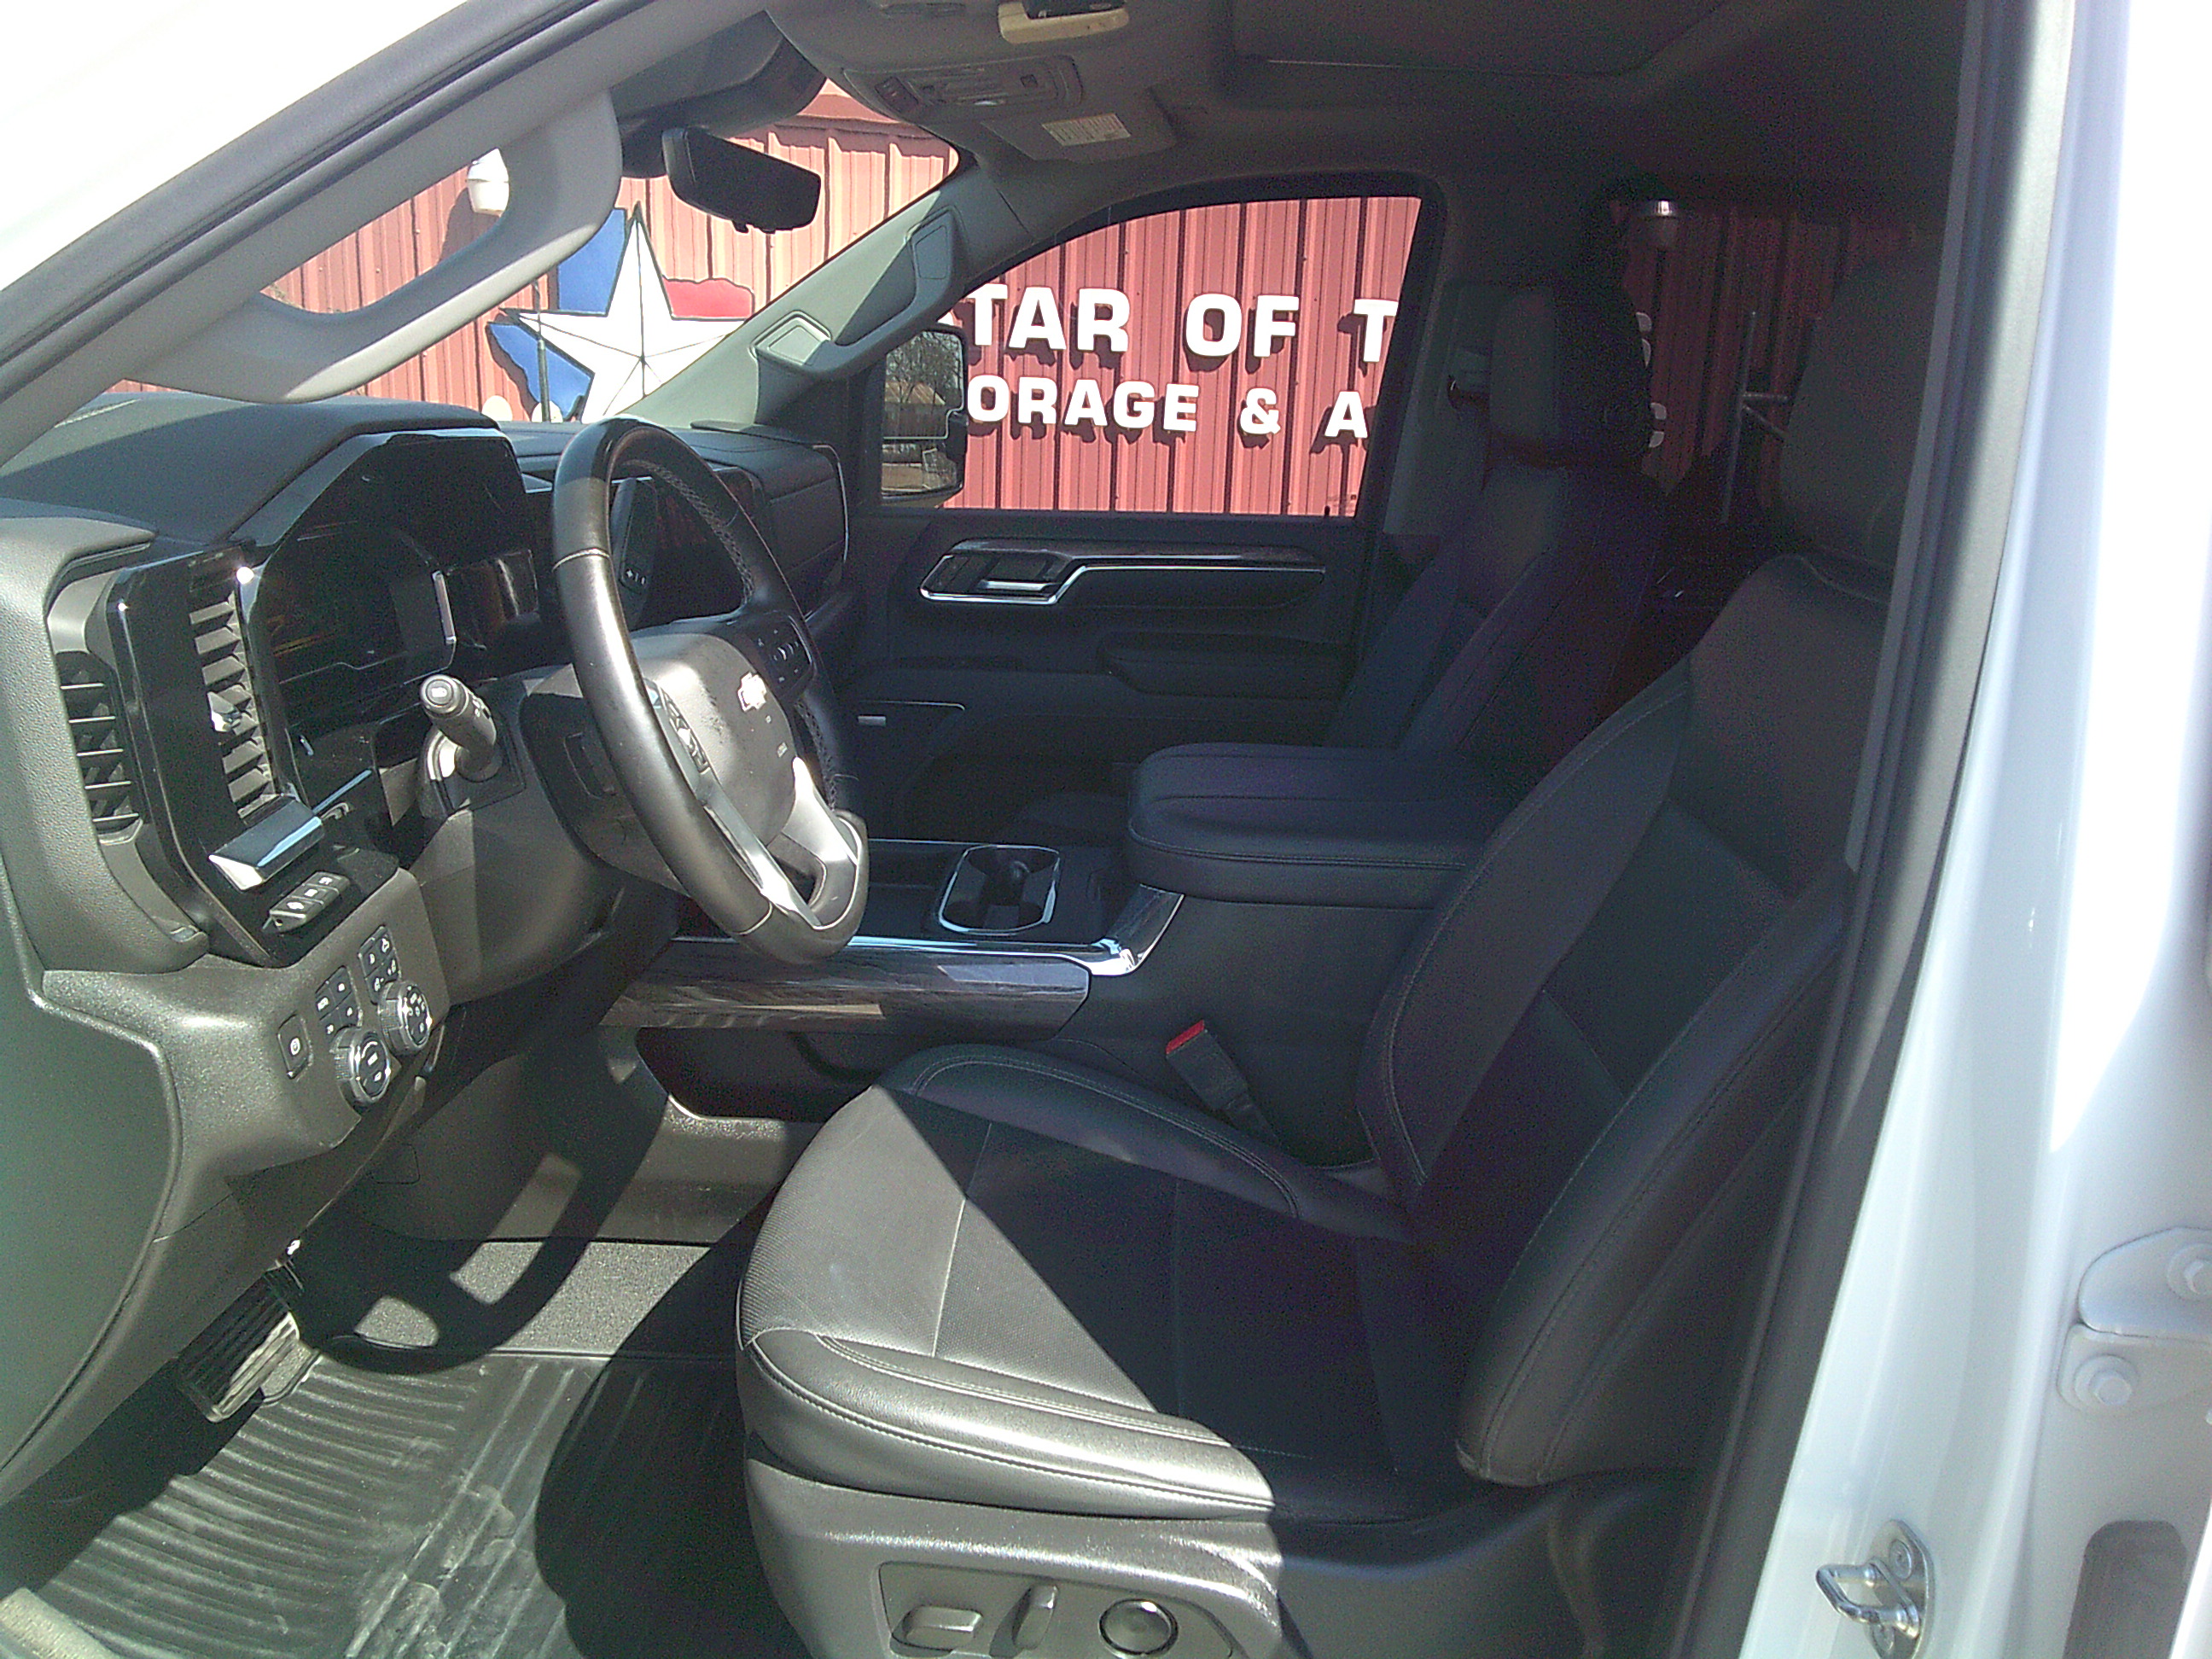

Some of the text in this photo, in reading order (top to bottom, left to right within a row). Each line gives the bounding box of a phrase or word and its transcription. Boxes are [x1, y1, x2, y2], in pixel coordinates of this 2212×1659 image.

[937, 283, 1399, 362] TAR OF T
[967, 375, 1368, 438] ORAGE & A
